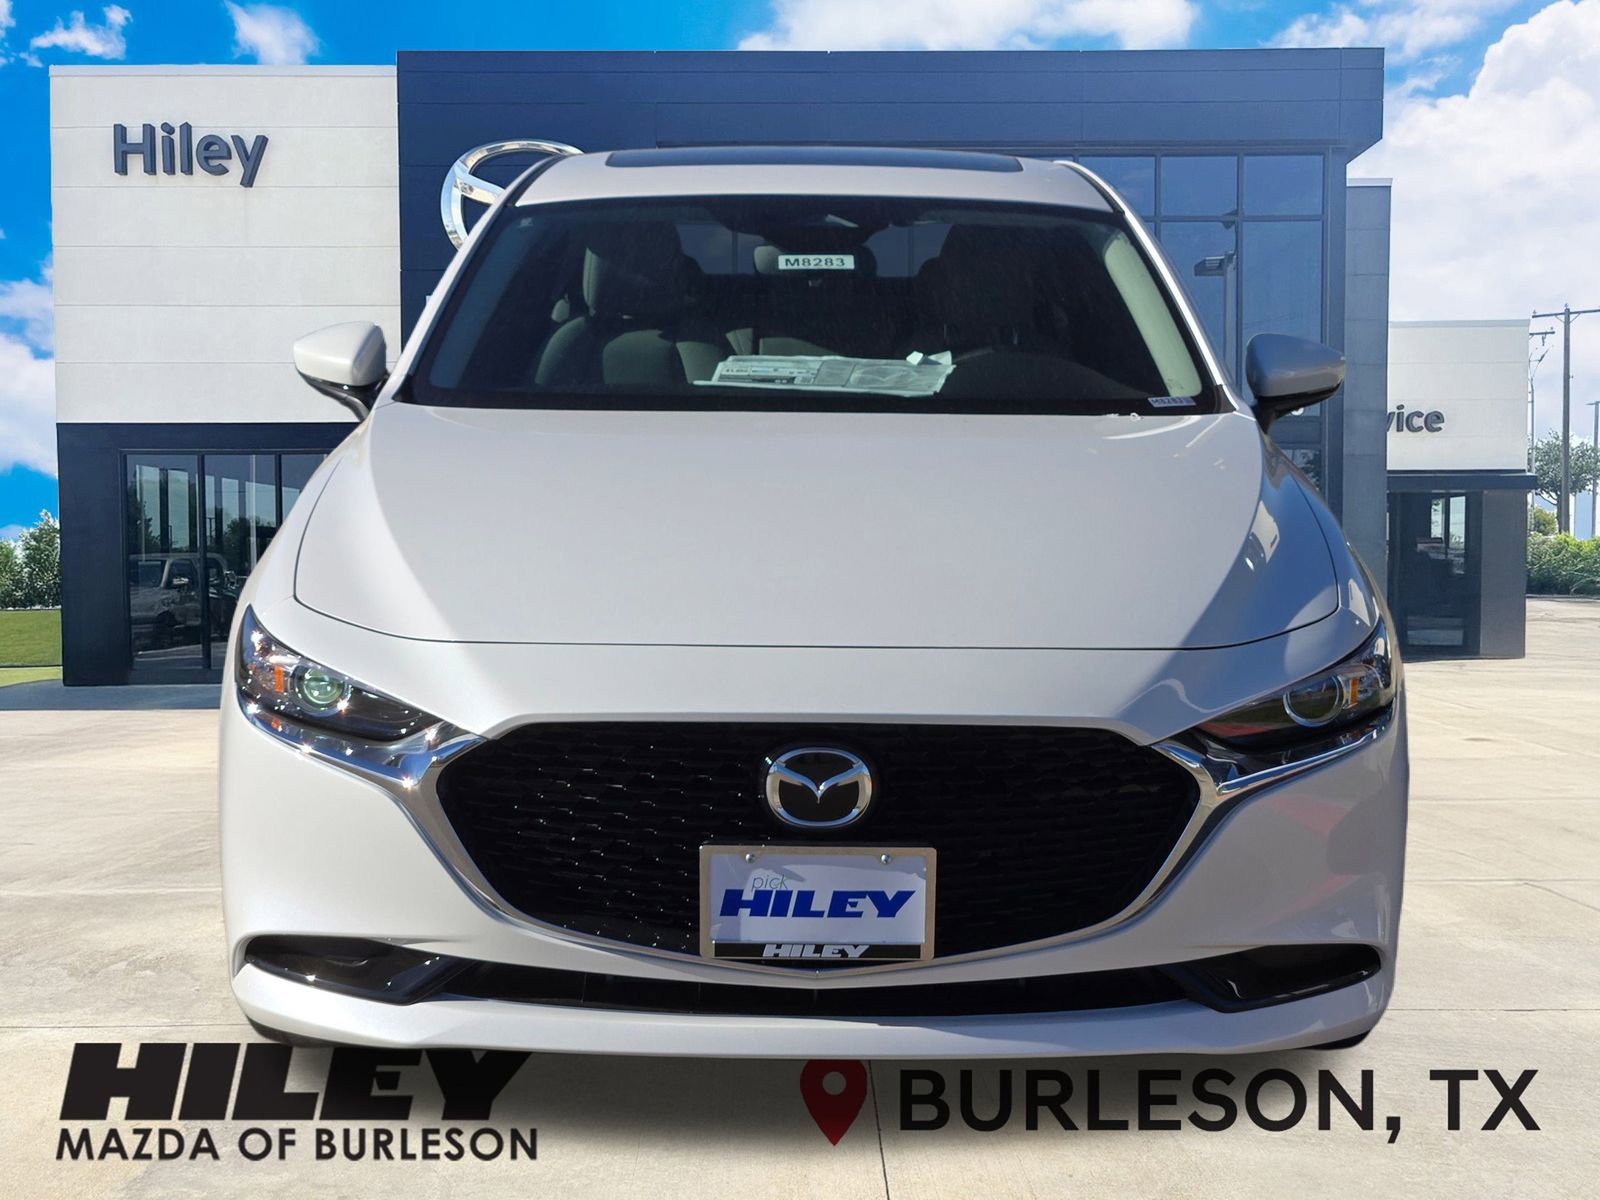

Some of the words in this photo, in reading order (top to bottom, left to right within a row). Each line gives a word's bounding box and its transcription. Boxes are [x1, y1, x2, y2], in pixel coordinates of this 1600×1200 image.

[113, 121, 269, 188] Hiley
[784, 257, 846, 267] M8283
[751, 874, 789, 892] pick
[719, 888, 916, 918] HILEY
[762, 943, 870, 958] HILEY
